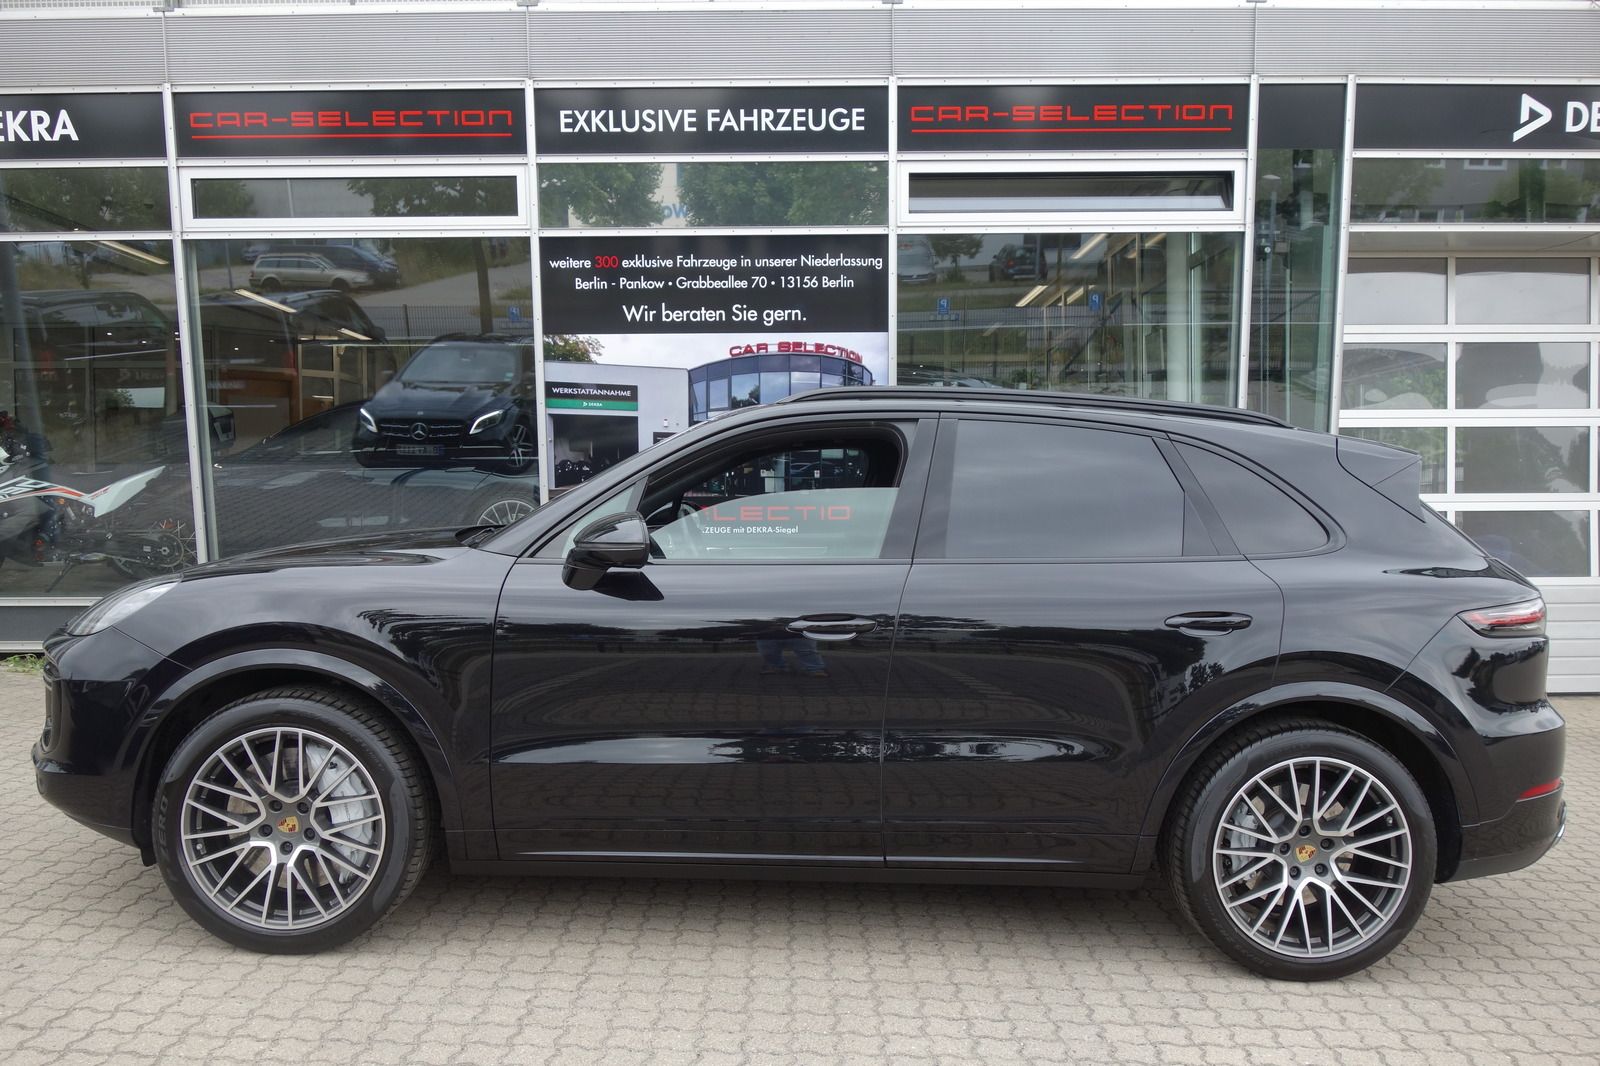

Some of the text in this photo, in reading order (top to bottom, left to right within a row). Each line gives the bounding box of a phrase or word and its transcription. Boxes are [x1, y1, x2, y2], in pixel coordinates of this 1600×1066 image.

[190, 110, 512, 128] CAR-SELECTION
[559, 107, 865, 133] EXKLUSIVE FAHRZEUGE
[911, 104, 1232, 122] CAR-SELECTION
[549, 253, 883, 271] weitere 300 exklusive Fahrzeuge in unserer Niederlassung
[575, 276, 608, 289] Berlin
[619, 276, 665, 289] Pankow
[676, 275, 748, 289] Grabbeallee
[751, 276, 767, 288] 70
[780, 276, 818, 288] 13156
[822, 275, 854, 288] Berlin
[622, 303, 807, 326] Wir beraten Sie gern.
[729, 341, 863, 364] CAR SELECTION
[551, 387, 632, 397] WERKSTATTANNAHME
[702, 525, 798, 534] ZEUGE mit DEKRA-Siegel
